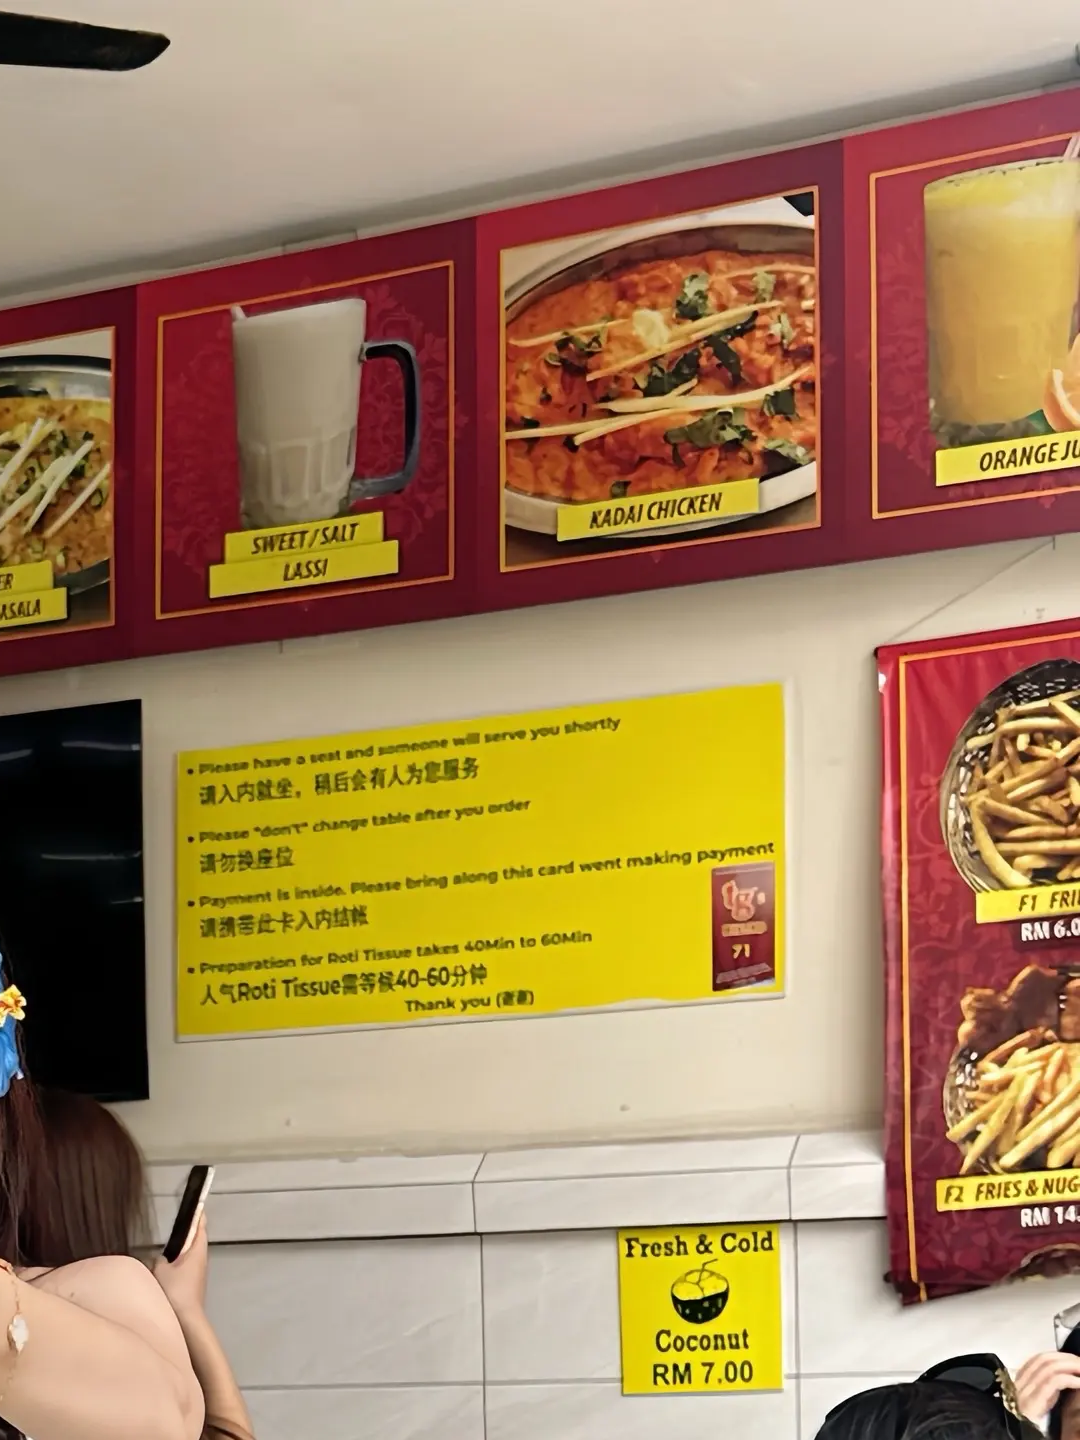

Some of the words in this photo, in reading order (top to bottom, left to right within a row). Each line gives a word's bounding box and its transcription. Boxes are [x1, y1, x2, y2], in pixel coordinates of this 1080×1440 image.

[980, 442, 1059, 472] ORANGE
[589, 503, 644, 529] KADAI
[647, 492, 723, 521] CHICKEN
[251, 530, 309, 555] SWEET
[320, 523, 360, 545] SALT
[283, 558, 328, 582] LASSI
[199, 760, 249, 775] Please
[253, 755, 291, 770] have
[296, 755, 306, 766] a
[310, 750, 341, 764] seat
[346, 745, 374, 760] and
[378, 738, 448, 756] someone
[453, 732, 480, 747] will
[484, 729, 526, 743] serve
[530, 725, 560, 741] you
[564, 717, 621, 735] shortly
[199, 829, 249, 843] Please
[313, 816, 368, 832] change
[372, 811, 411, 826] table
[415, 808, 451, 822] after
[455, 805, 483, 820] you
[488, 799, 531, 815] order
[199, 890, 272, 909] Payment
[277, 888, 290, 901] is
[295, 884, 346, 901] inside.
[350, 880, 402, 894] Please
[406, 874, 448, 889] bring
[453, 870, 498, 884] along
[502, 864, 533, 880] this
[538, 860, 574, 876] card
[579, 857, 622, 872] went
[627, 850, 692, 868] making
[697, 842, 775, 863] payment
[1018, 894, 1038, 912] F1
[1021, 921, 1051, 941] RM
[199, 957, 296, 975] Preparation
[301, 953, 323, 966] for
[328, 949, 358, 964] Roti
[363, 946, 412, 961] Tissue
[417, 943, 459, 957] takes
[464, 936, 515, 952] 40Min
[520, 936, 536, 948] to
[541, 931, 592, 946] 60Min
[405, 996, 455, 1012] Thank
[461, 997, 491, 1012] you
[944, 1185, 964, 1204] F2
[975, 1180, 1021, 1202] FRIES
[1025, 1179, 1039, 1197] &
[1020, 1207, 1051, 1227] RM
[625, 1235, 689, 1258] Fresh
[696, 1233, 713, 1255] &
[720, 1230, 774, 1254] Cold
[655, 1328, 750, 1353] Coconut
[653, 1362, 692, 1386] RM
[701, 1360, 753, 1384] 7.00
